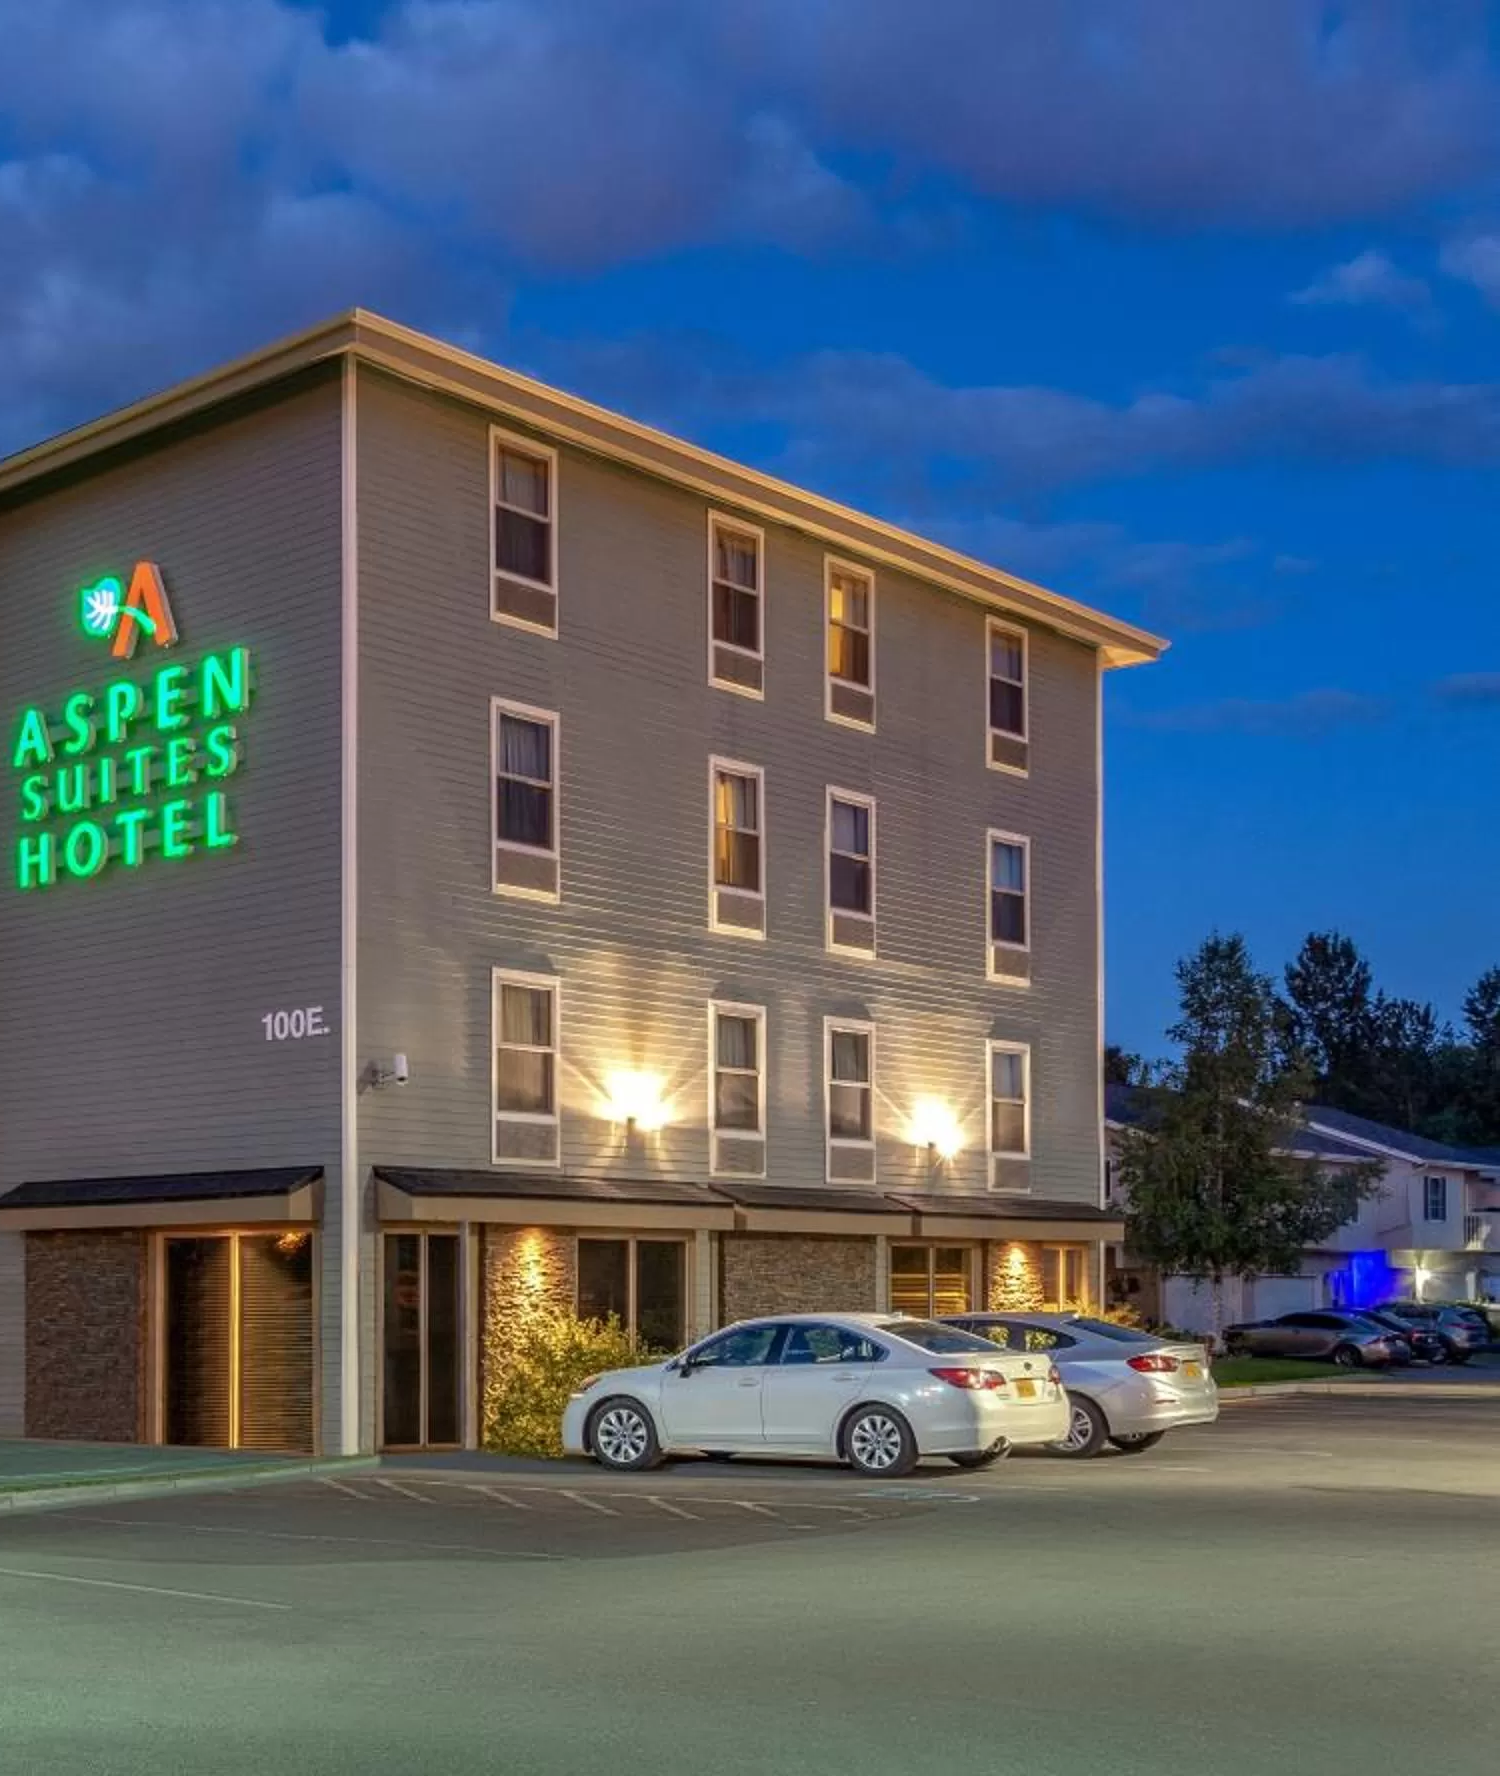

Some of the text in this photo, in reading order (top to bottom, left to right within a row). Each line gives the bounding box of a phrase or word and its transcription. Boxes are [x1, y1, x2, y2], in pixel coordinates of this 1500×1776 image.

[13, 646, 250, 768] ASPEN
[20, 725, 238, 821] SUITES
[17, 791, 239, 889] HOTEL
[261, 1005, 331, 1041] 100E.
